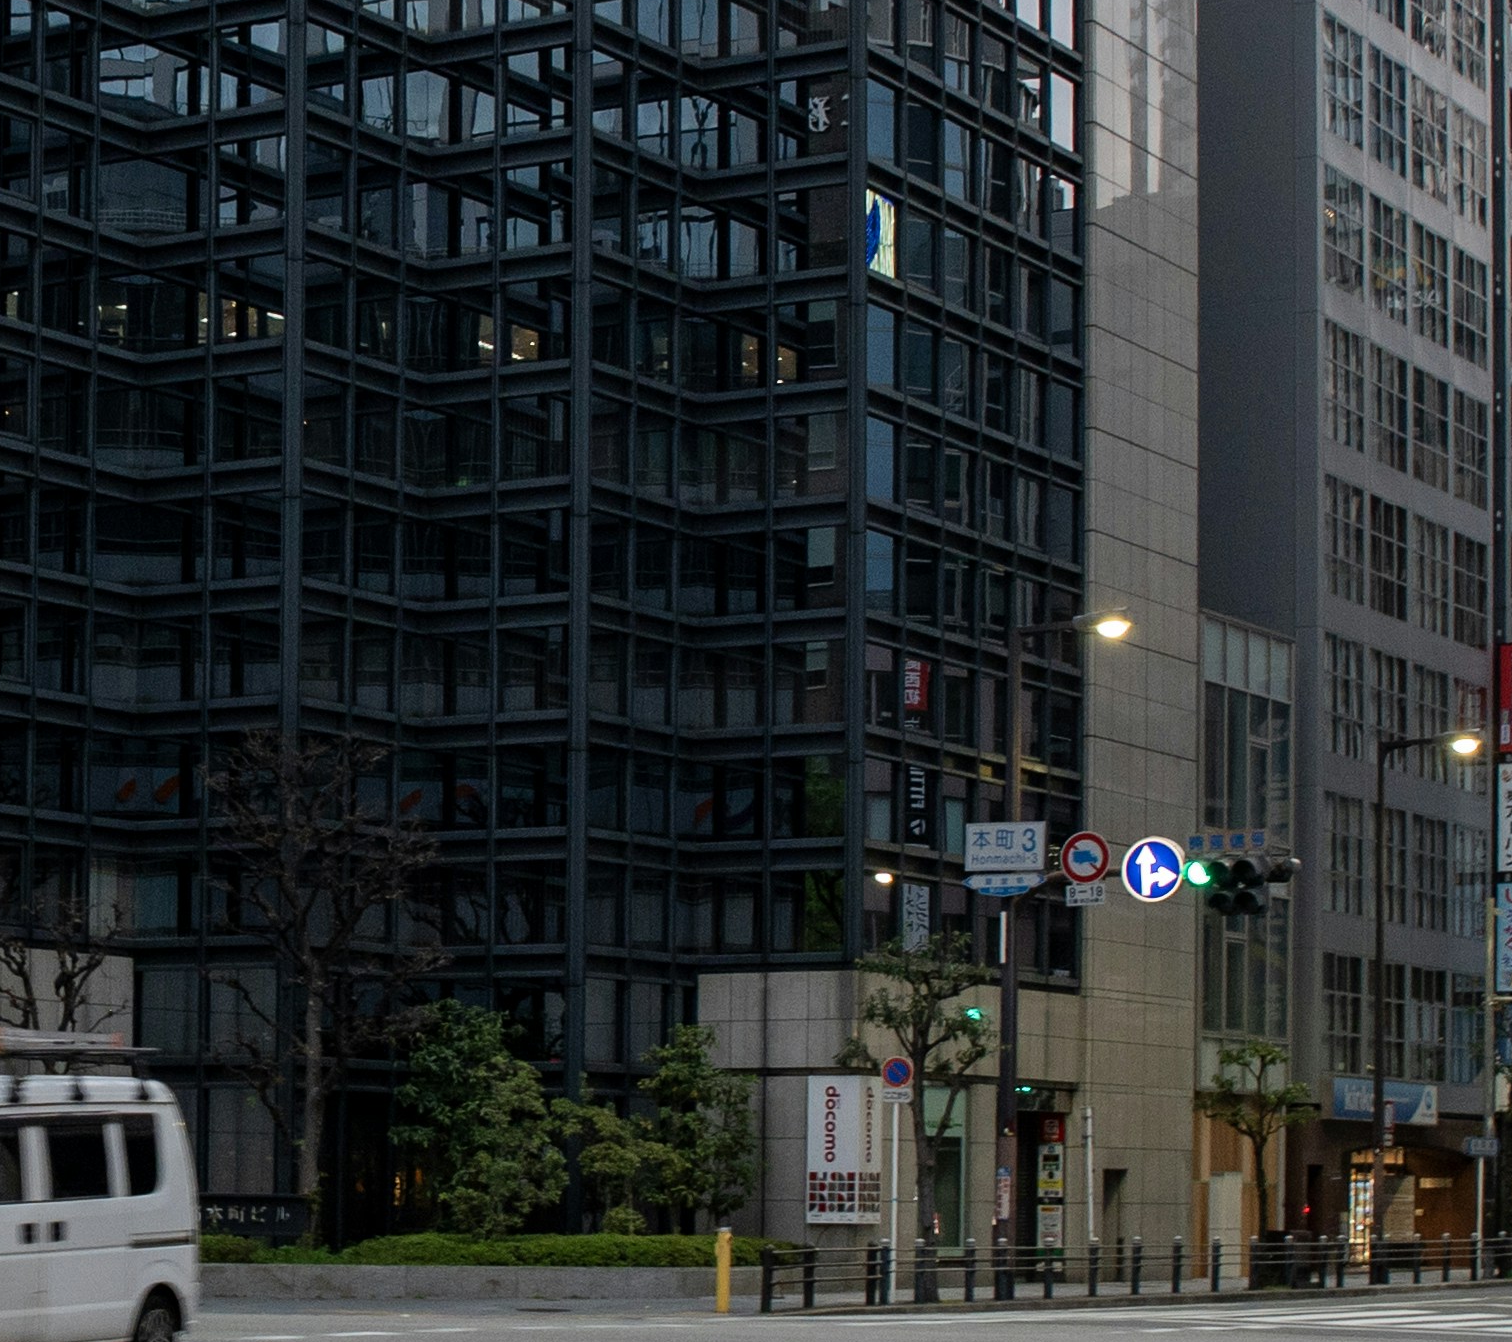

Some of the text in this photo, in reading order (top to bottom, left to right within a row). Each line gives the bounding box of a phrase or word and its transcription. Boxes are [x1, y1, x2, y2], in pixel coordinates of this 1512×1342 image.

[972, 828, 1036, 852] 本町 3
[825, 1085, 840, 1163] docomo
[866, 1086, 875, 1163] docomo
